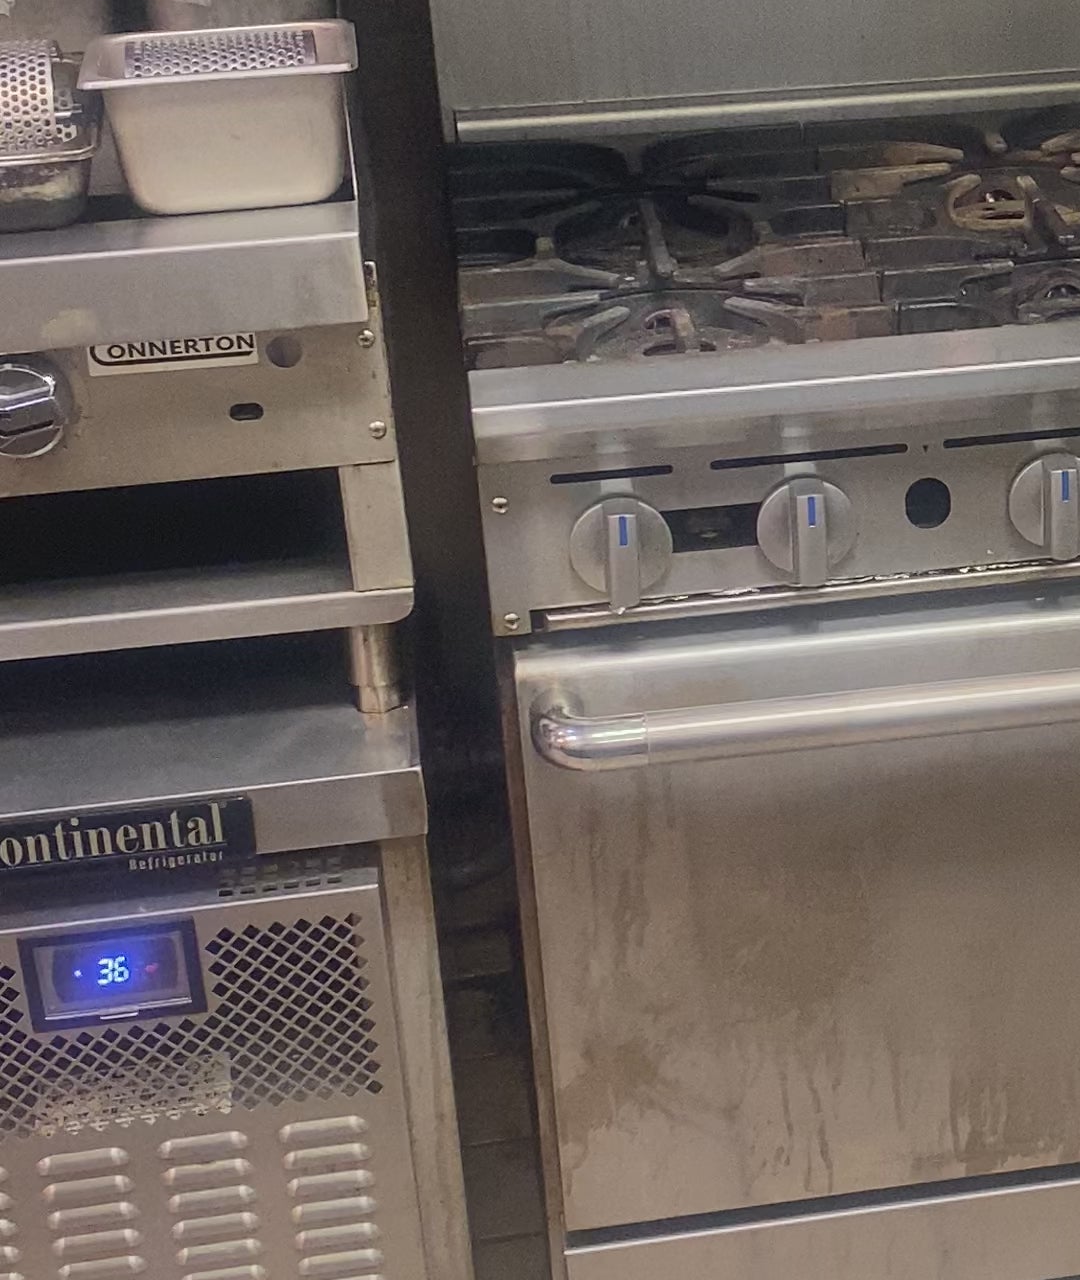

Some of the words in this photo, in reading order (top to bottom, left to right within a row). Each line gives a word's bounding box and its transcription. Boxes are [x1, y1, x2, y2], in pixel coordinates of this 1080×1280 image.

[0, 802, 226, 867] ontinental
[129, 851, 224, 871] Refrigerator
[97, 956, 130, 985] 36
